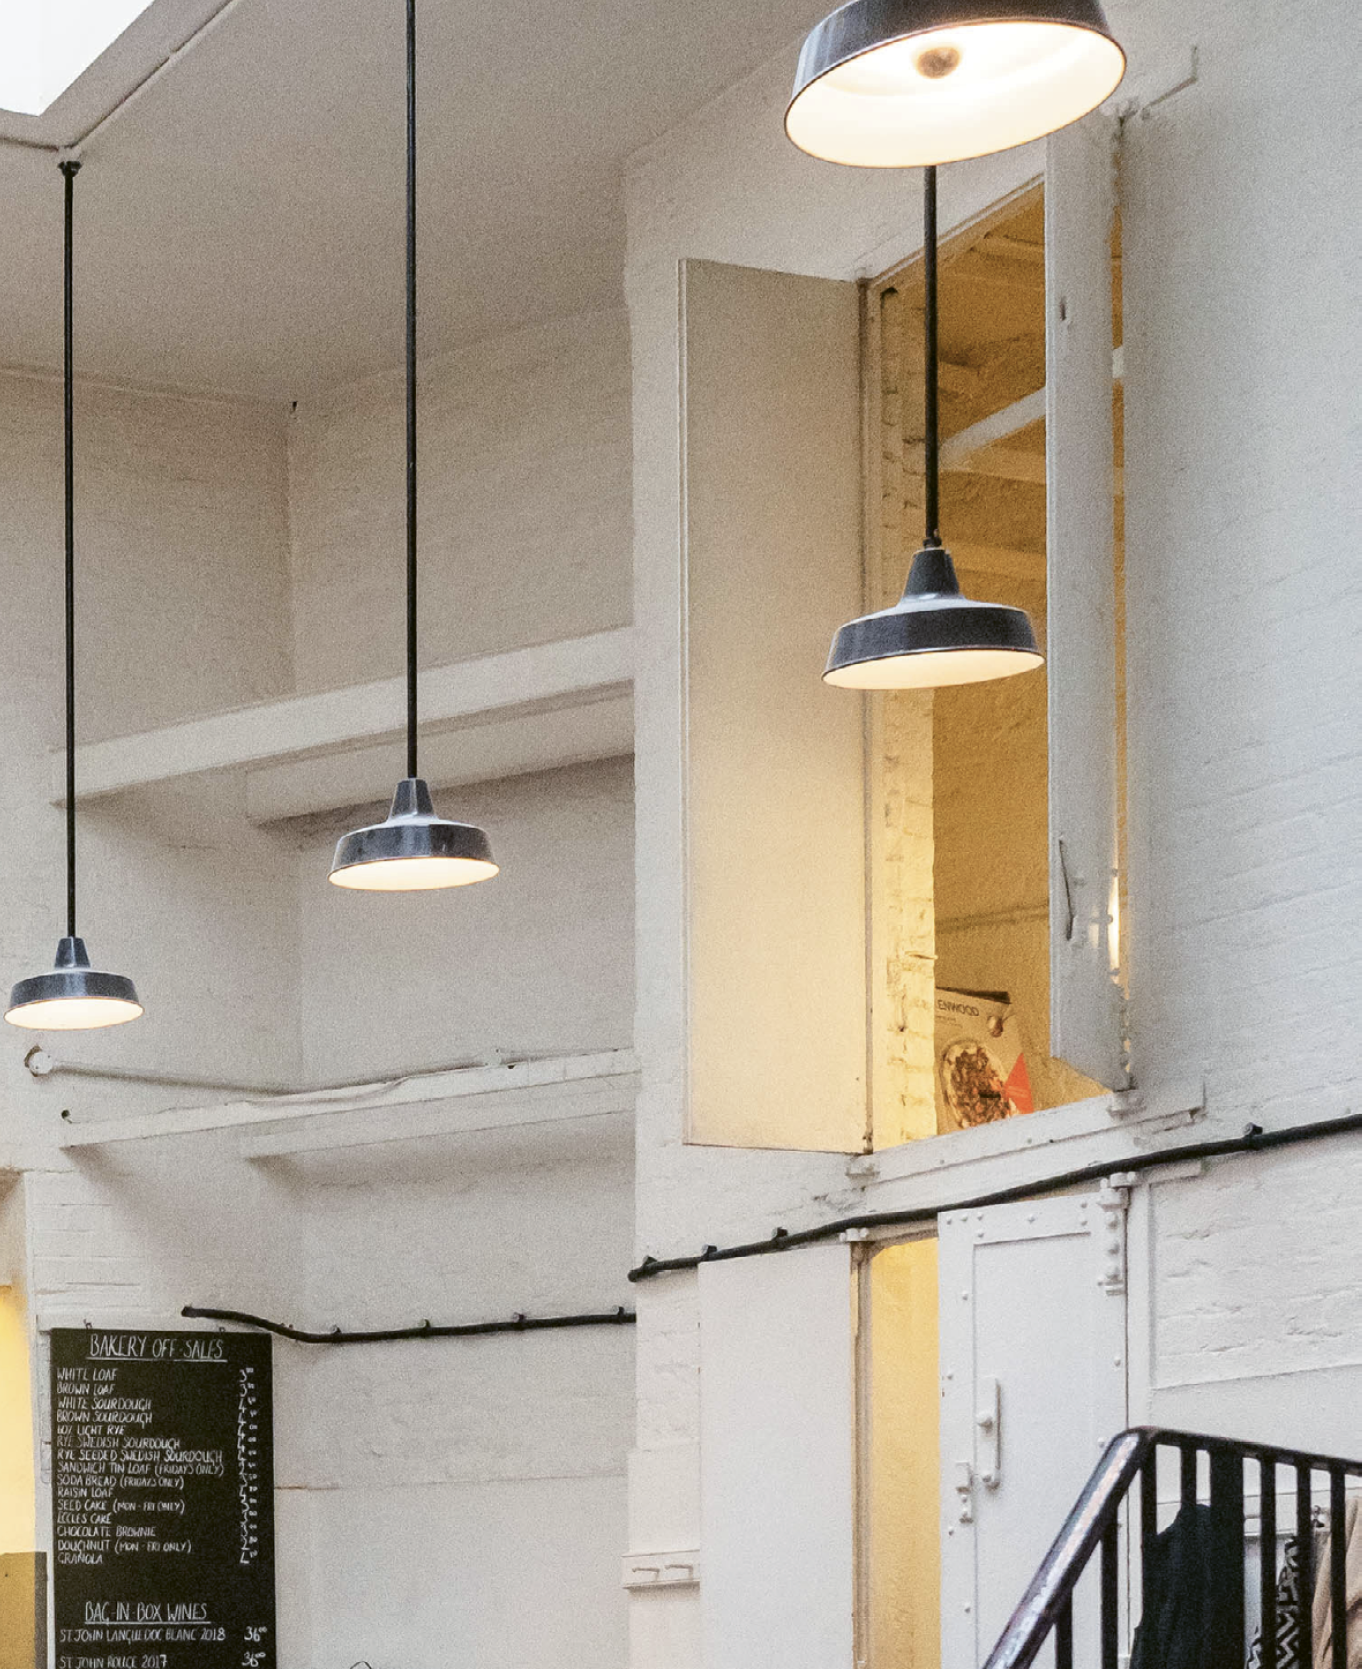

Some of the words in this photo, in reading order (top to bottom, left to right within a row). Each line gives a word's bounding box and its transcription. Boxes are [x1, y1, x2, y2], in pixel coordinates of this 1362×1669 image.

[936, 999, 980, 1017] ENWOOD
[90, 1333, 147, 1357] BAKERY
[57, 1367, 89, 1381] WHITE
[92, 1367, 119, 1381] LOAF
[57, 1381, 90, 1395] BROWN
[93, 1383, 116, 1396] LOAF
[58, 1396, 89, 1410] WHITE
[91, 1397, 152, 1411] SOURDOUGH
[57, 1409, 90, 1423] BROWN
[92, 1411, 153, 1428] SOURDOUGH
[77, 1425, 103, 1437] LIGHT
[106, 1424, 127, 1436] RYE
[57, 1435, 73, 1448] RYE
[77, 1435, 119, 1448] SWEDISH
[122, 1436, 180, 1449] SOURDOUGH
[57, 1448, 75, 1460] RYE
[78, 1448, 118, 1461] SEEDED
[120, 1449, 160, 1462] SWEDISH
[163, 1449, 223, 1465] SOURDOUGH
[57, 1461, 106, 1474] SANDWICH
[109, 1461, 125, 1474] TIN
[127, 1462, 151, 1475] LOAF
[57, 1473, 83, 1486] SODA
[85, 1474, 117, 1487] BREAD
[57, 1487, 88, 1499] RAISIN
[91, 1487, 114, 1498] LOAF
[57, 1499, 82, 1511] SEED
[84, 1499, 107, 1511] CAKE
[57, 1511, 88, 1524] ECCLES
[90, 1511, 112, 1524] CAKE
[57, 1525, 111, 1537] CHOCOLATE
[116, 1525, 157, 1537] BROWNIE
[58, 1539, 111, 1553] DOUGHNUT
[57, 1552, 103, 1565] GRANOLA
[167, 1602, 208, 1621] WINES
[59, 1628, 73, 1643] ST
[73, 1628, 103, 1643] JOHN
[106, 1629, 163, 1644] LANGUEDOC
[165, 1628, 198, 1640] BLANC
[200, 1626, 226, 1641] 2018
[59, 1655, 73, 1669] ST
[77, 1655, 104, 1669] JOHN
[141, 1653, 168, 1669] 2017
